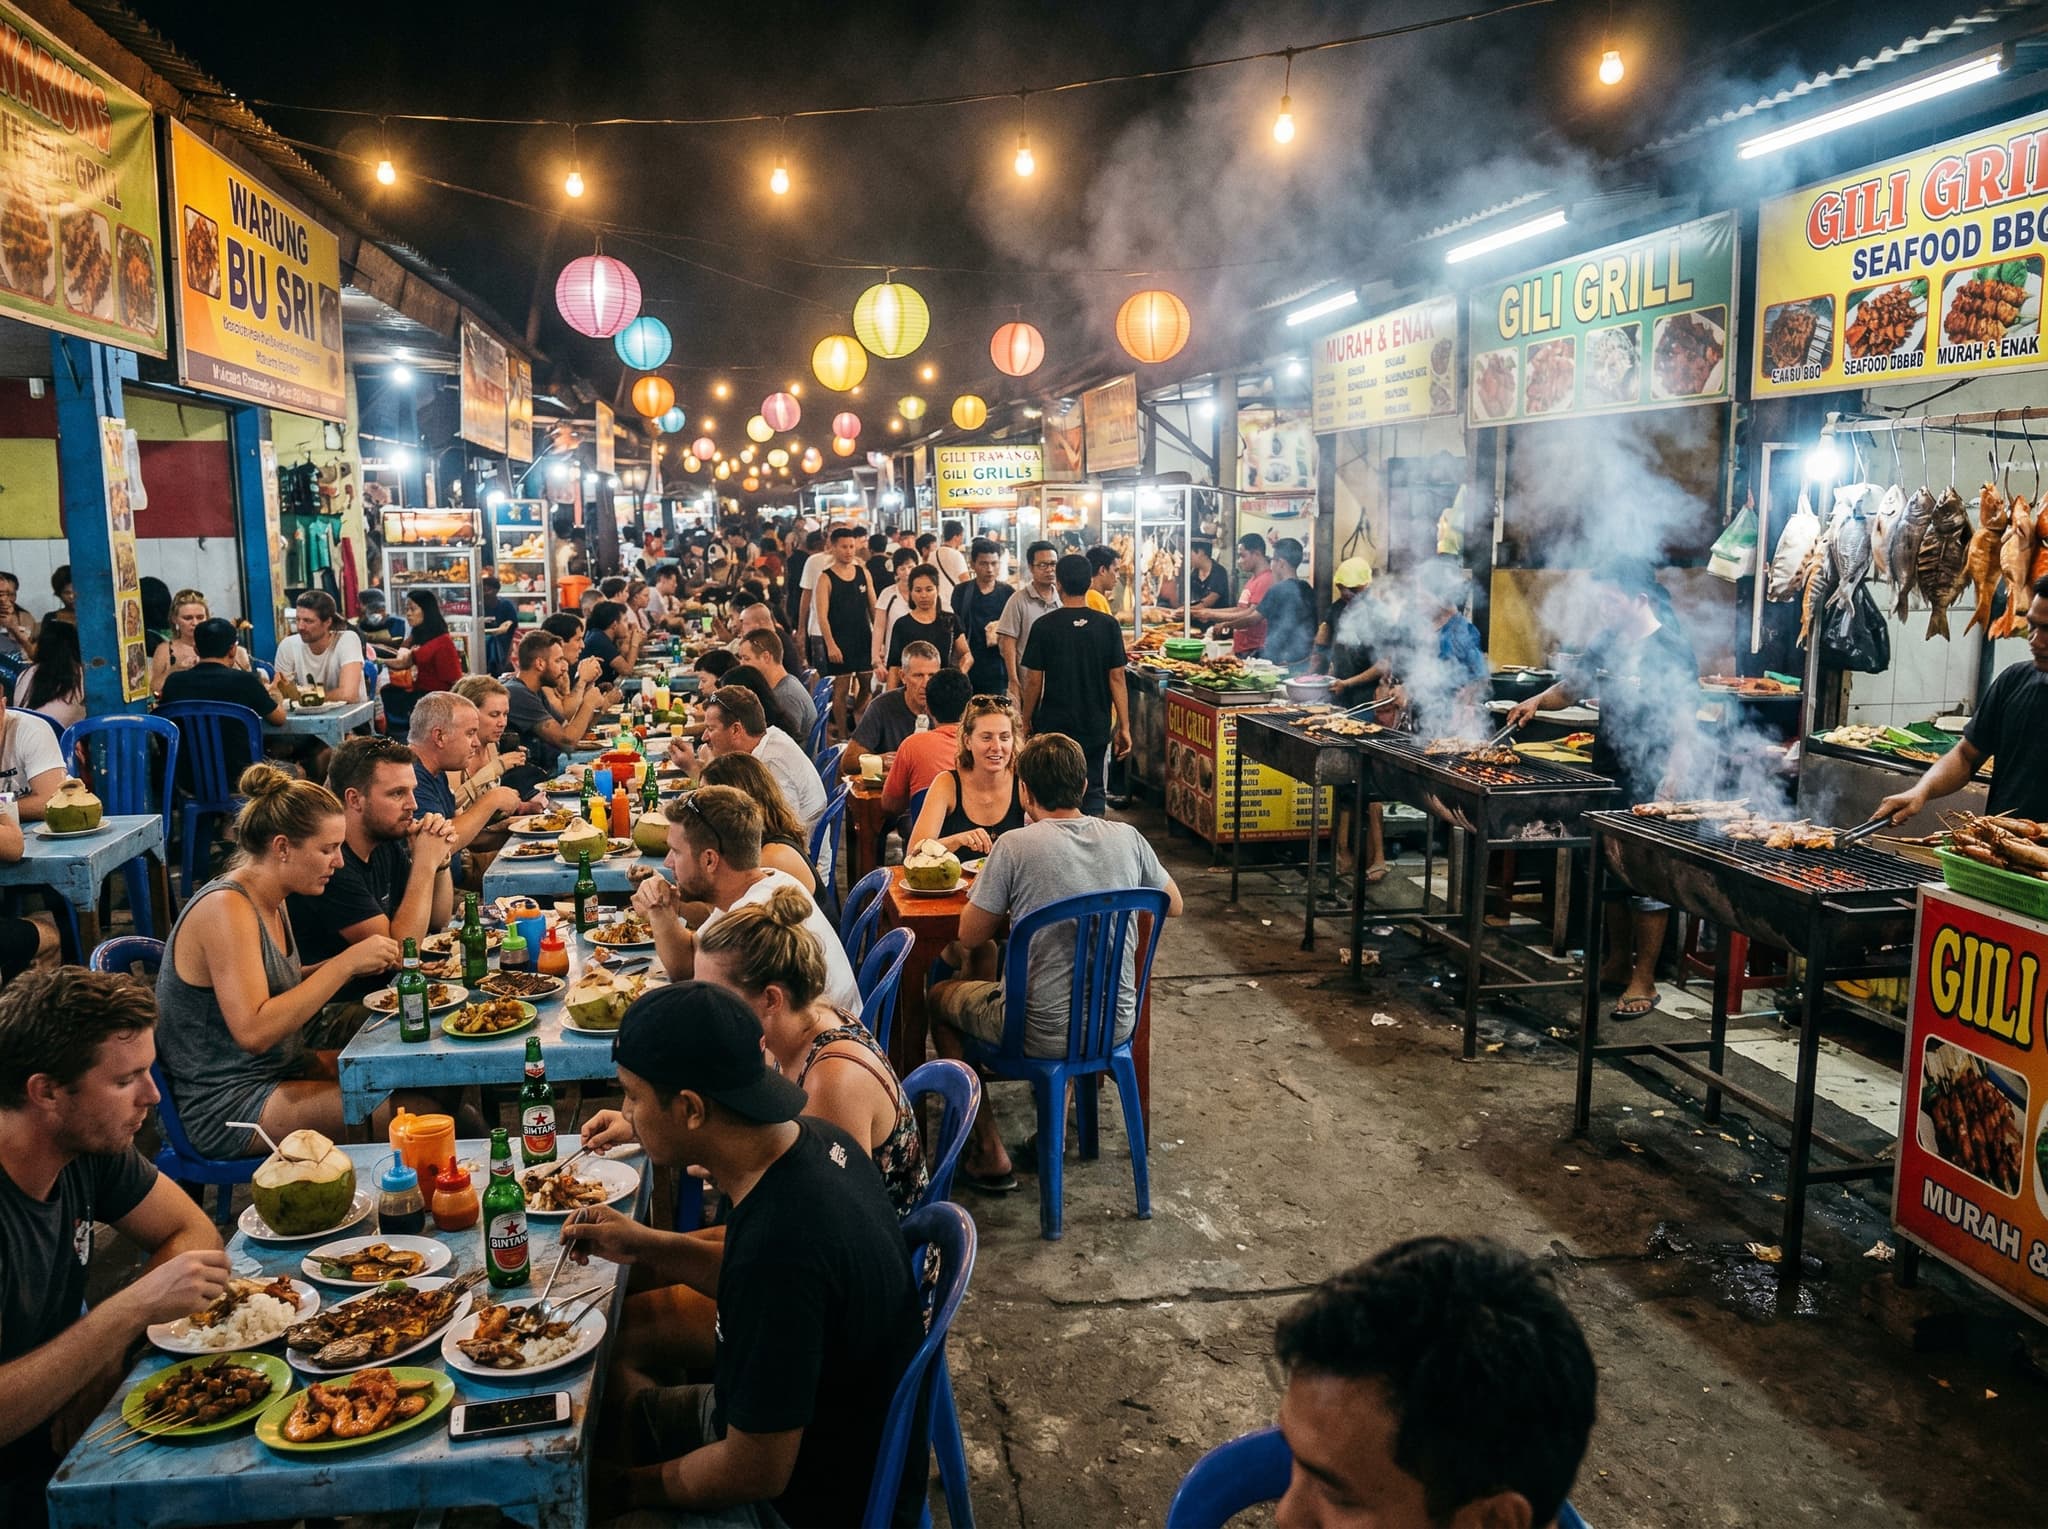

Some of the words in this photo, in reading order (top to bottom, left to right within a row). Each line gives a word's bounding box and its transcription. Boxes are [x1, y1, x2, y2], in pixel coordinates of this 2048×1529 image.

[229, 177, 308, 266] WARUNG
[1807, 170, 1909, 250] GILI
[1852, 223, 1980, 281] SEAFOOD
[227, 237, 266, 320] BU
[276, 265, 316, 341] SRI
[1498, 272, 1562, 340] GILI
[1574, 241, 1694, 323] GRILL
[1326, 328, 1373, 364] MURAH
[1377, 325, 1387, 352] &
[1393, 312, 1434, 348] ENAK
[1937, 344, 1981, 365] MURAH
[1987, 347, 1996, 359] &
[2000, 336, 2039, 357] ENAK
[1844, 356, 1887, 376] SEAFOOD
[941, 452, 966, 463] GILI
[943, 470, 966, 480] GILI
[1168, 702, 1184, 736] GILI
[1186, 709, 1212, 750] GRILL
[491, 1231, 528, 1249] BINTAN
[1922, 1178, 2020, 1261] MURAH
